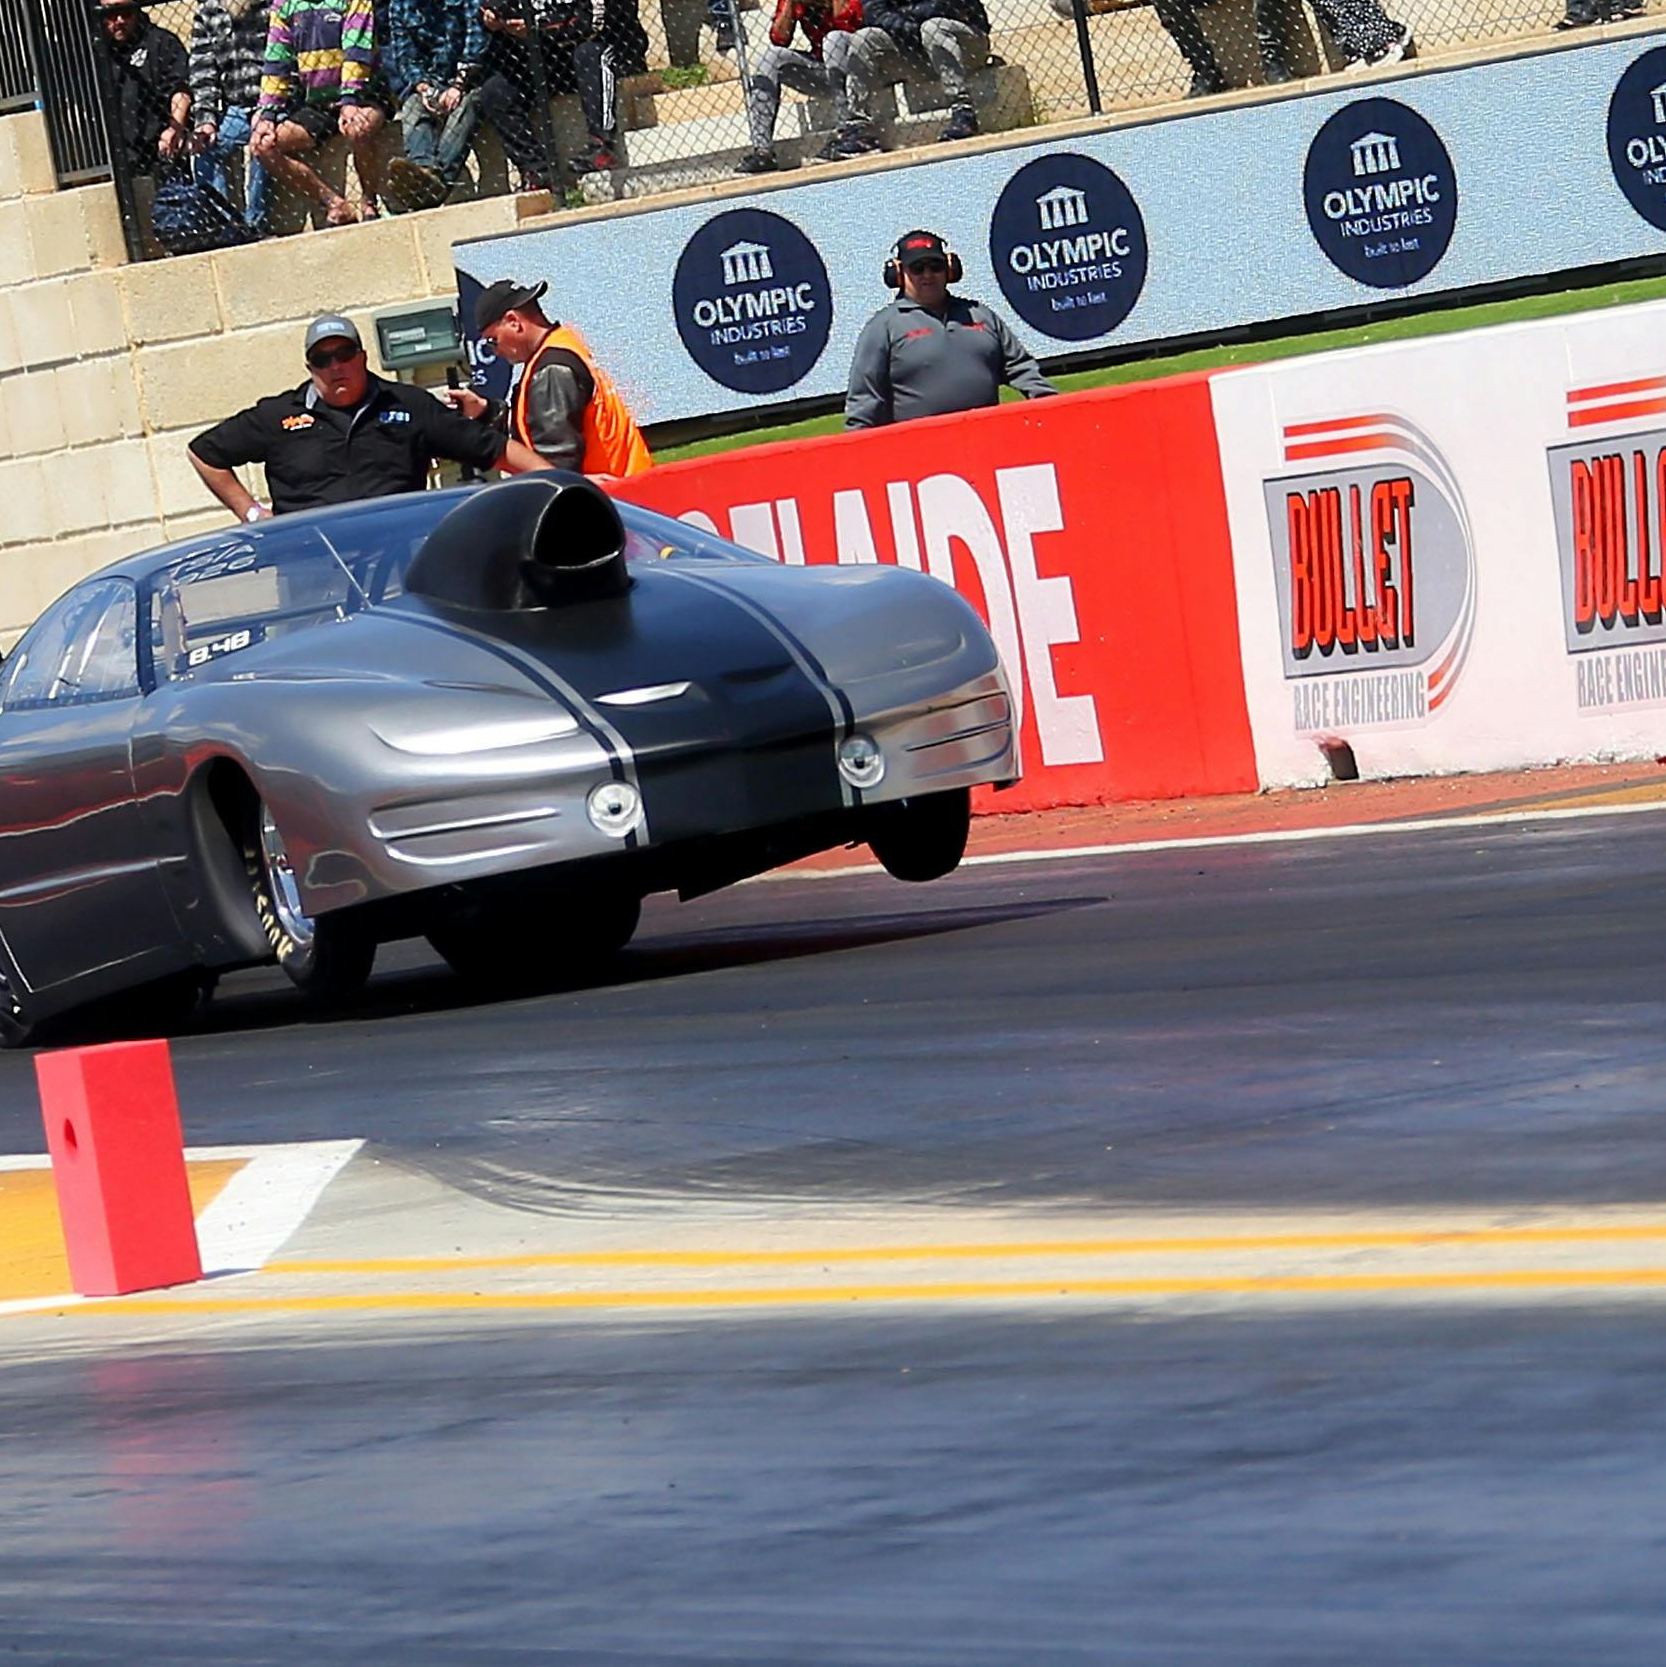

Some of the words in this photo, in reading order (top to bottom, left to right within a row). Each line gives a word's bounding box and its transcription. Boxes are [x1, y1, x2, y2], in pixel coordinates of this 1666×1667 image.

[1324, 174, 1440, 219] OLYMPIC
[1340, 207, 1433, 237] INDUSTRIES
[1010, 228, 1131, 273] OLYMPIC
[1027, 262, 1122, 291] INDUSTRIES
[693, 282, 815, 327] OLYMPIC
[711, 316, 806, 345] INDUSTRIES
[1285, 476, 1416, 662] BULLET
[189, 630, 251, 666] 8.48
[1293, 681, 1331, 732] RACE
[1333, 669, 1427, 728] ENGINEERING
[1576, 658, 1615, 710] RACE
